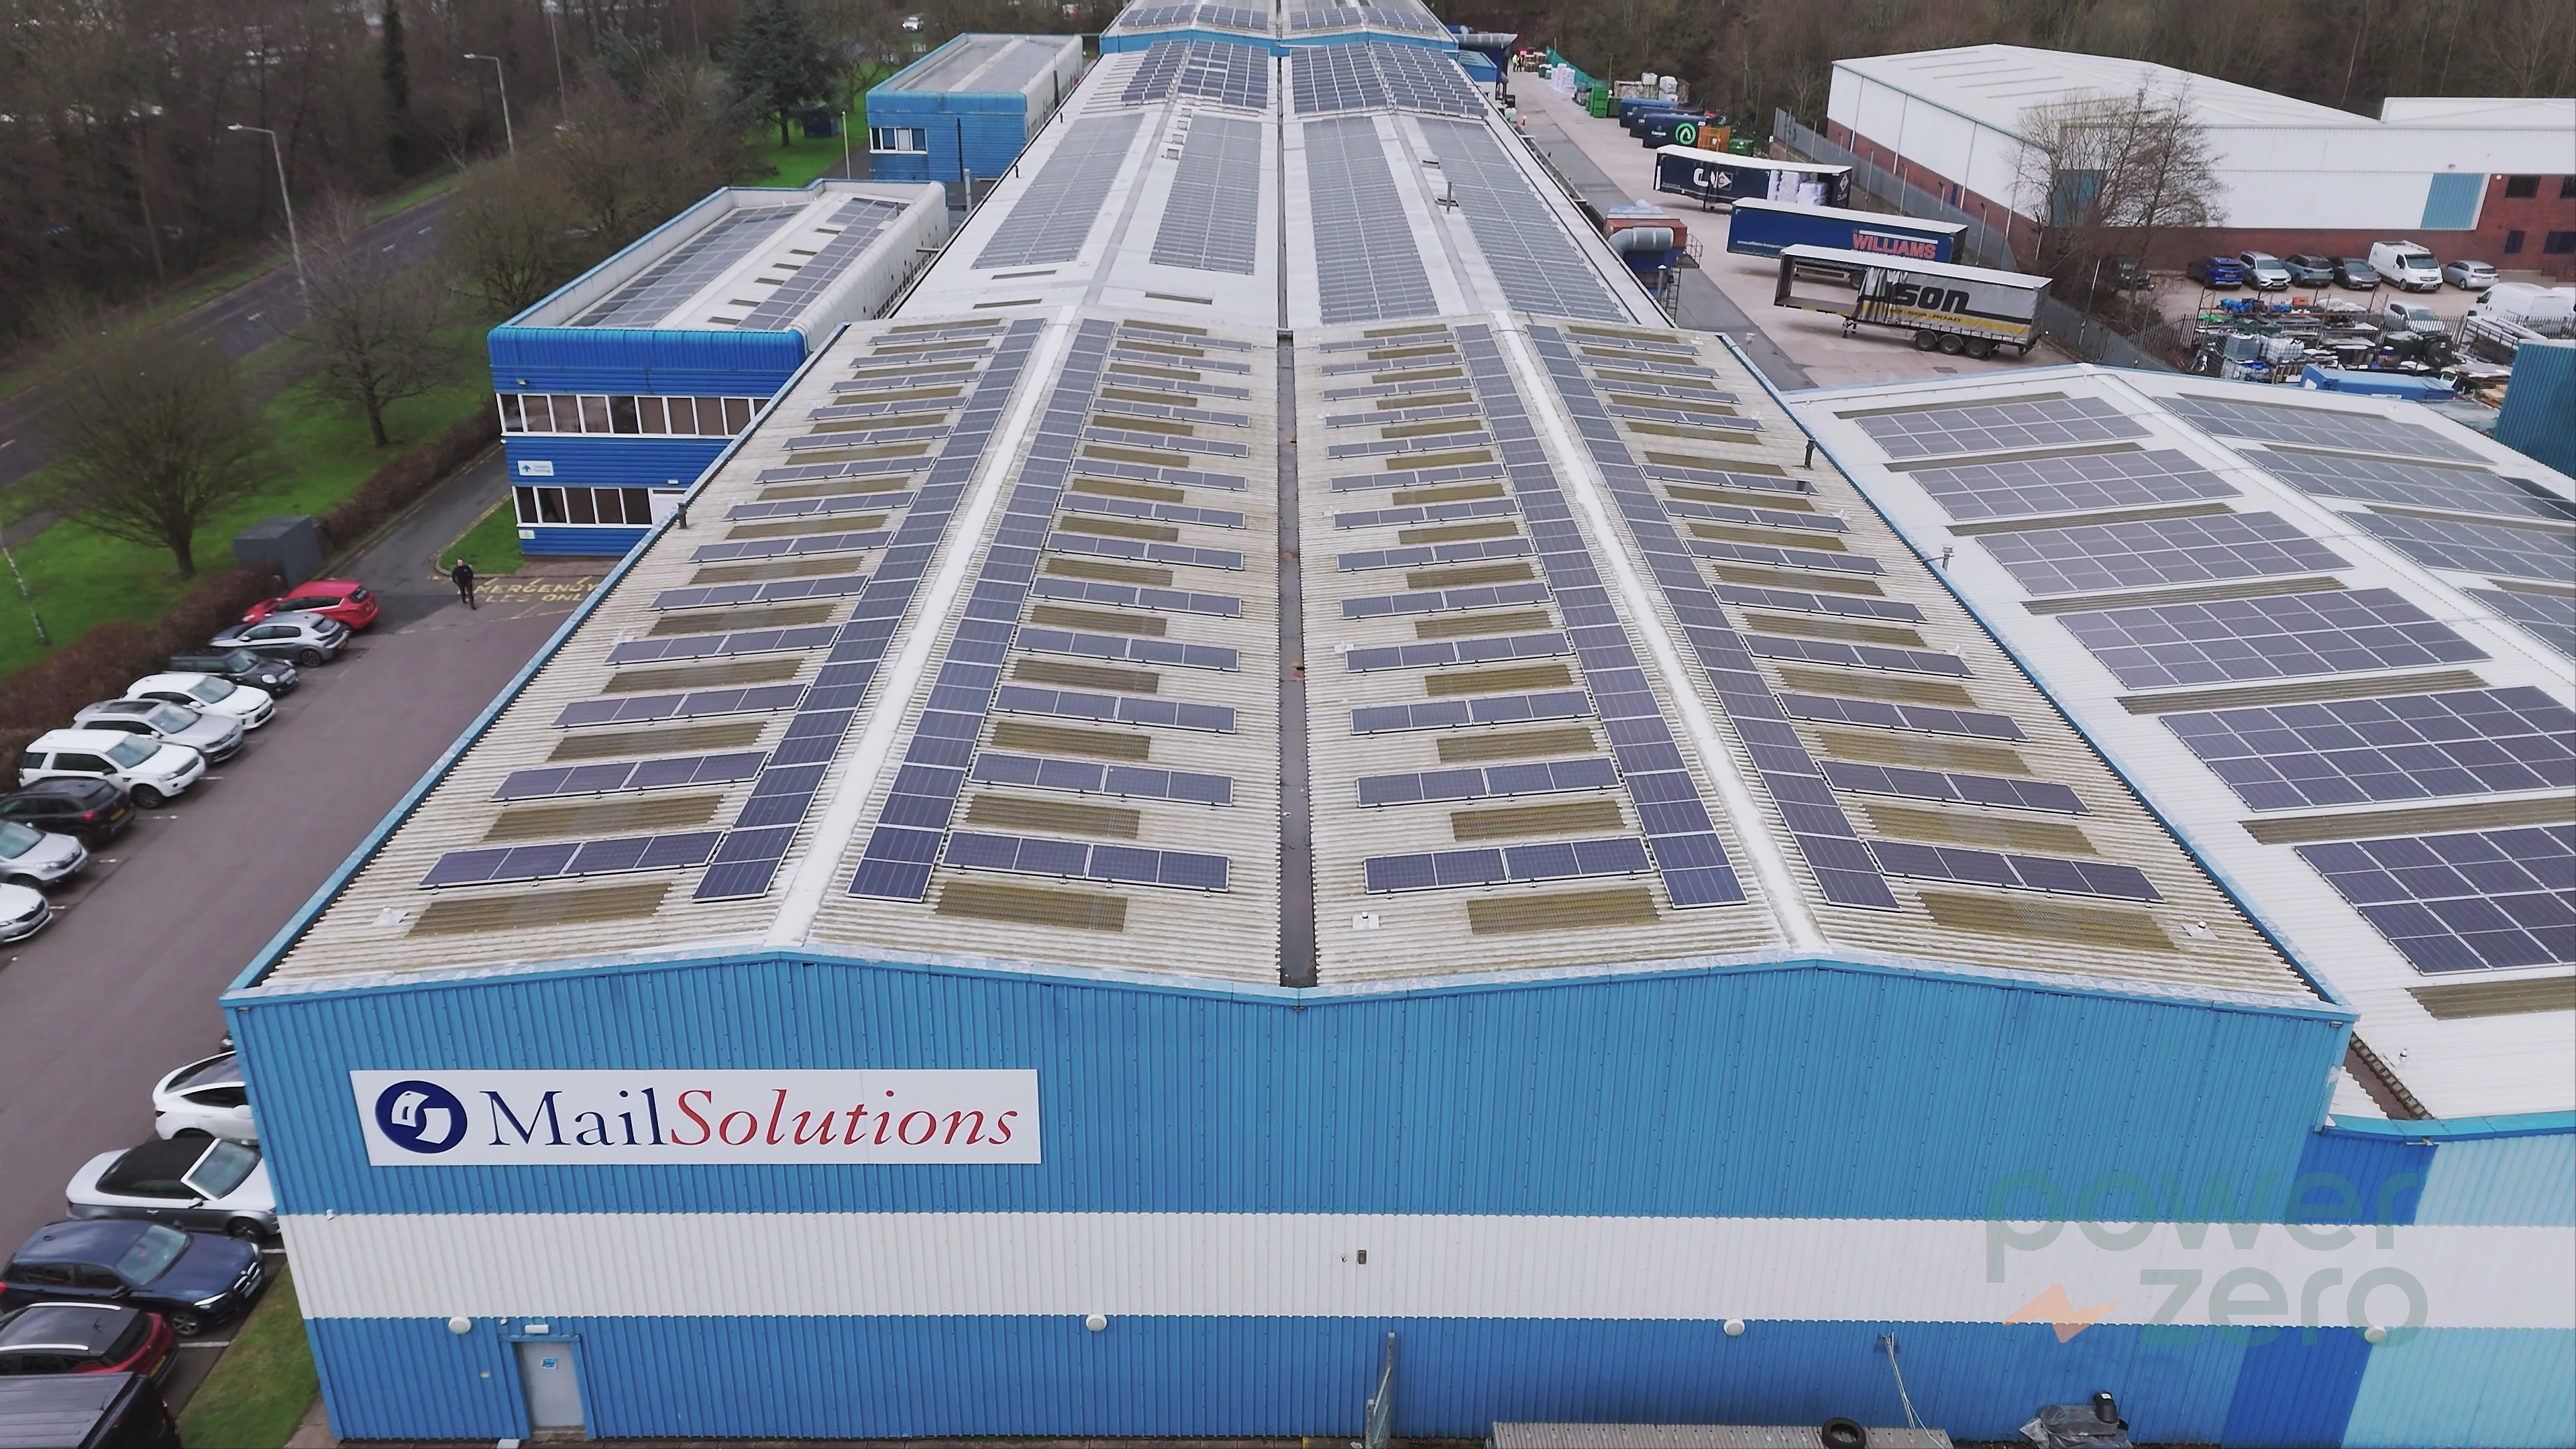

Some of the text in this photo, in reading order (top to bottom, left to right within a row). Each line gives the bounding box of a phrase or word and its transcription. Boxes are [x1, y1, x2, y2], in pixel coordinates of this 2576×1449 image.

[1853, 233, 1937, 260] WILLIAMS
[1932, 314, 1962, 323] ROAD
[473, 583, 599, 594] MERGENCY
[541, 593, 586, 602] ONL
[479, 1087, 1018, 1146] MailSolutions
